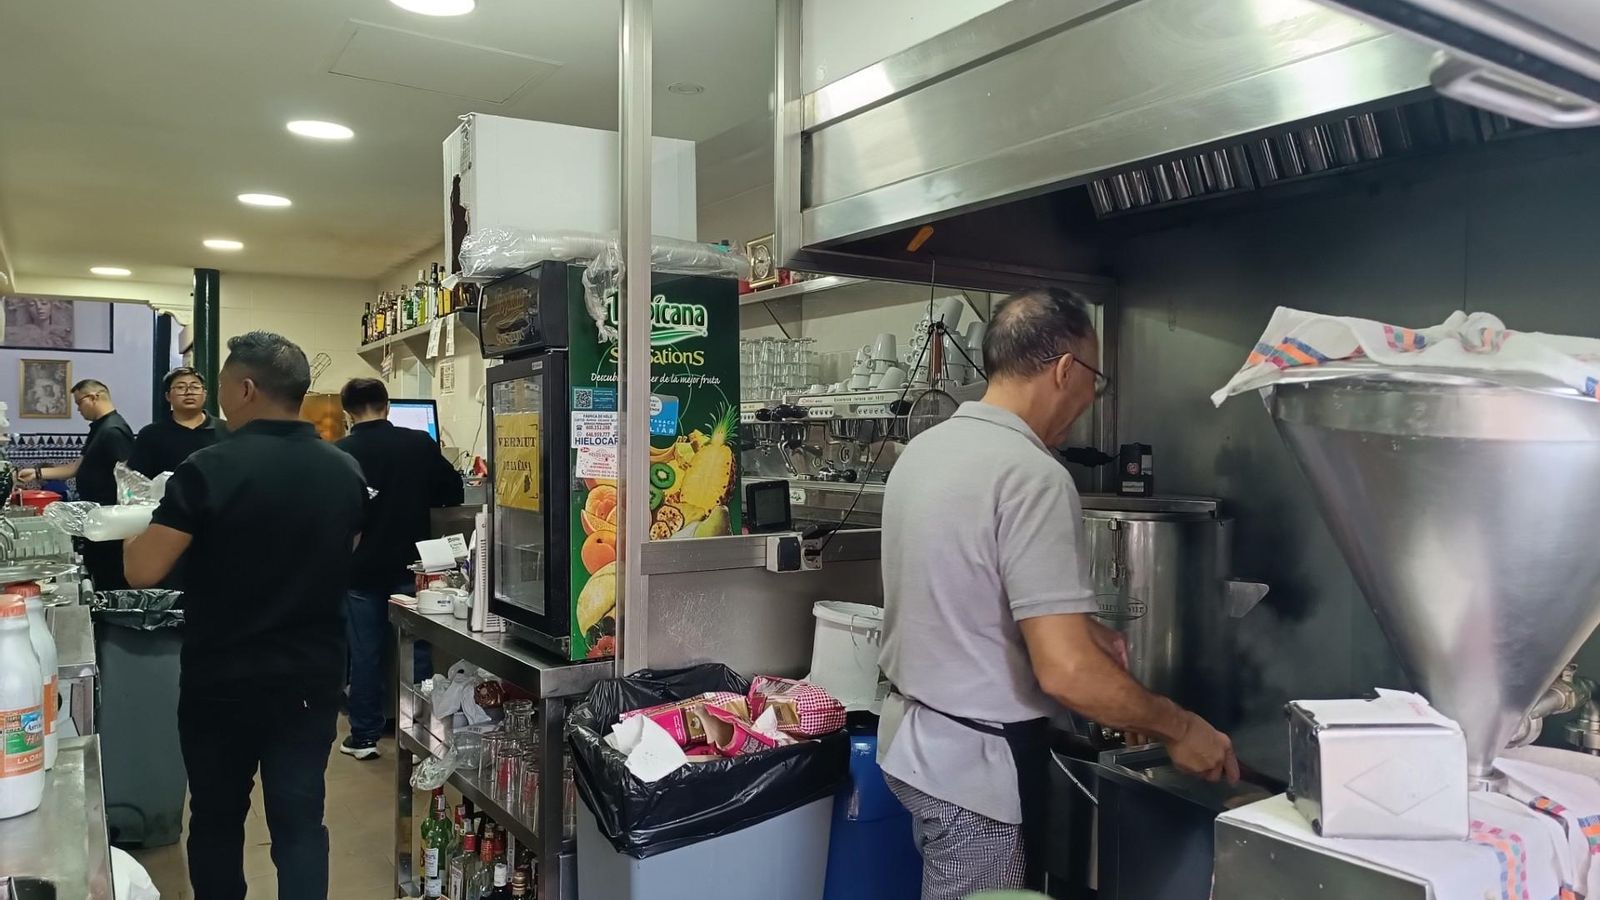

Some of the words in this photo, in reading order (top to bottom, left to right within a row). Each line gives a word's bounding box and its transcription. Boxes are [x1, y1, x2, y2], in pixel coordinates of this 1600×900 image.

[591, 372, 618, 382] Descub
[659, 372, 669, 383] de
[670, 373, 680, 383] la
[680, 374, 700, 388] mejor
[698, 373, 721, 389] fruta
[498, 436, 536, 448] VERMUT
